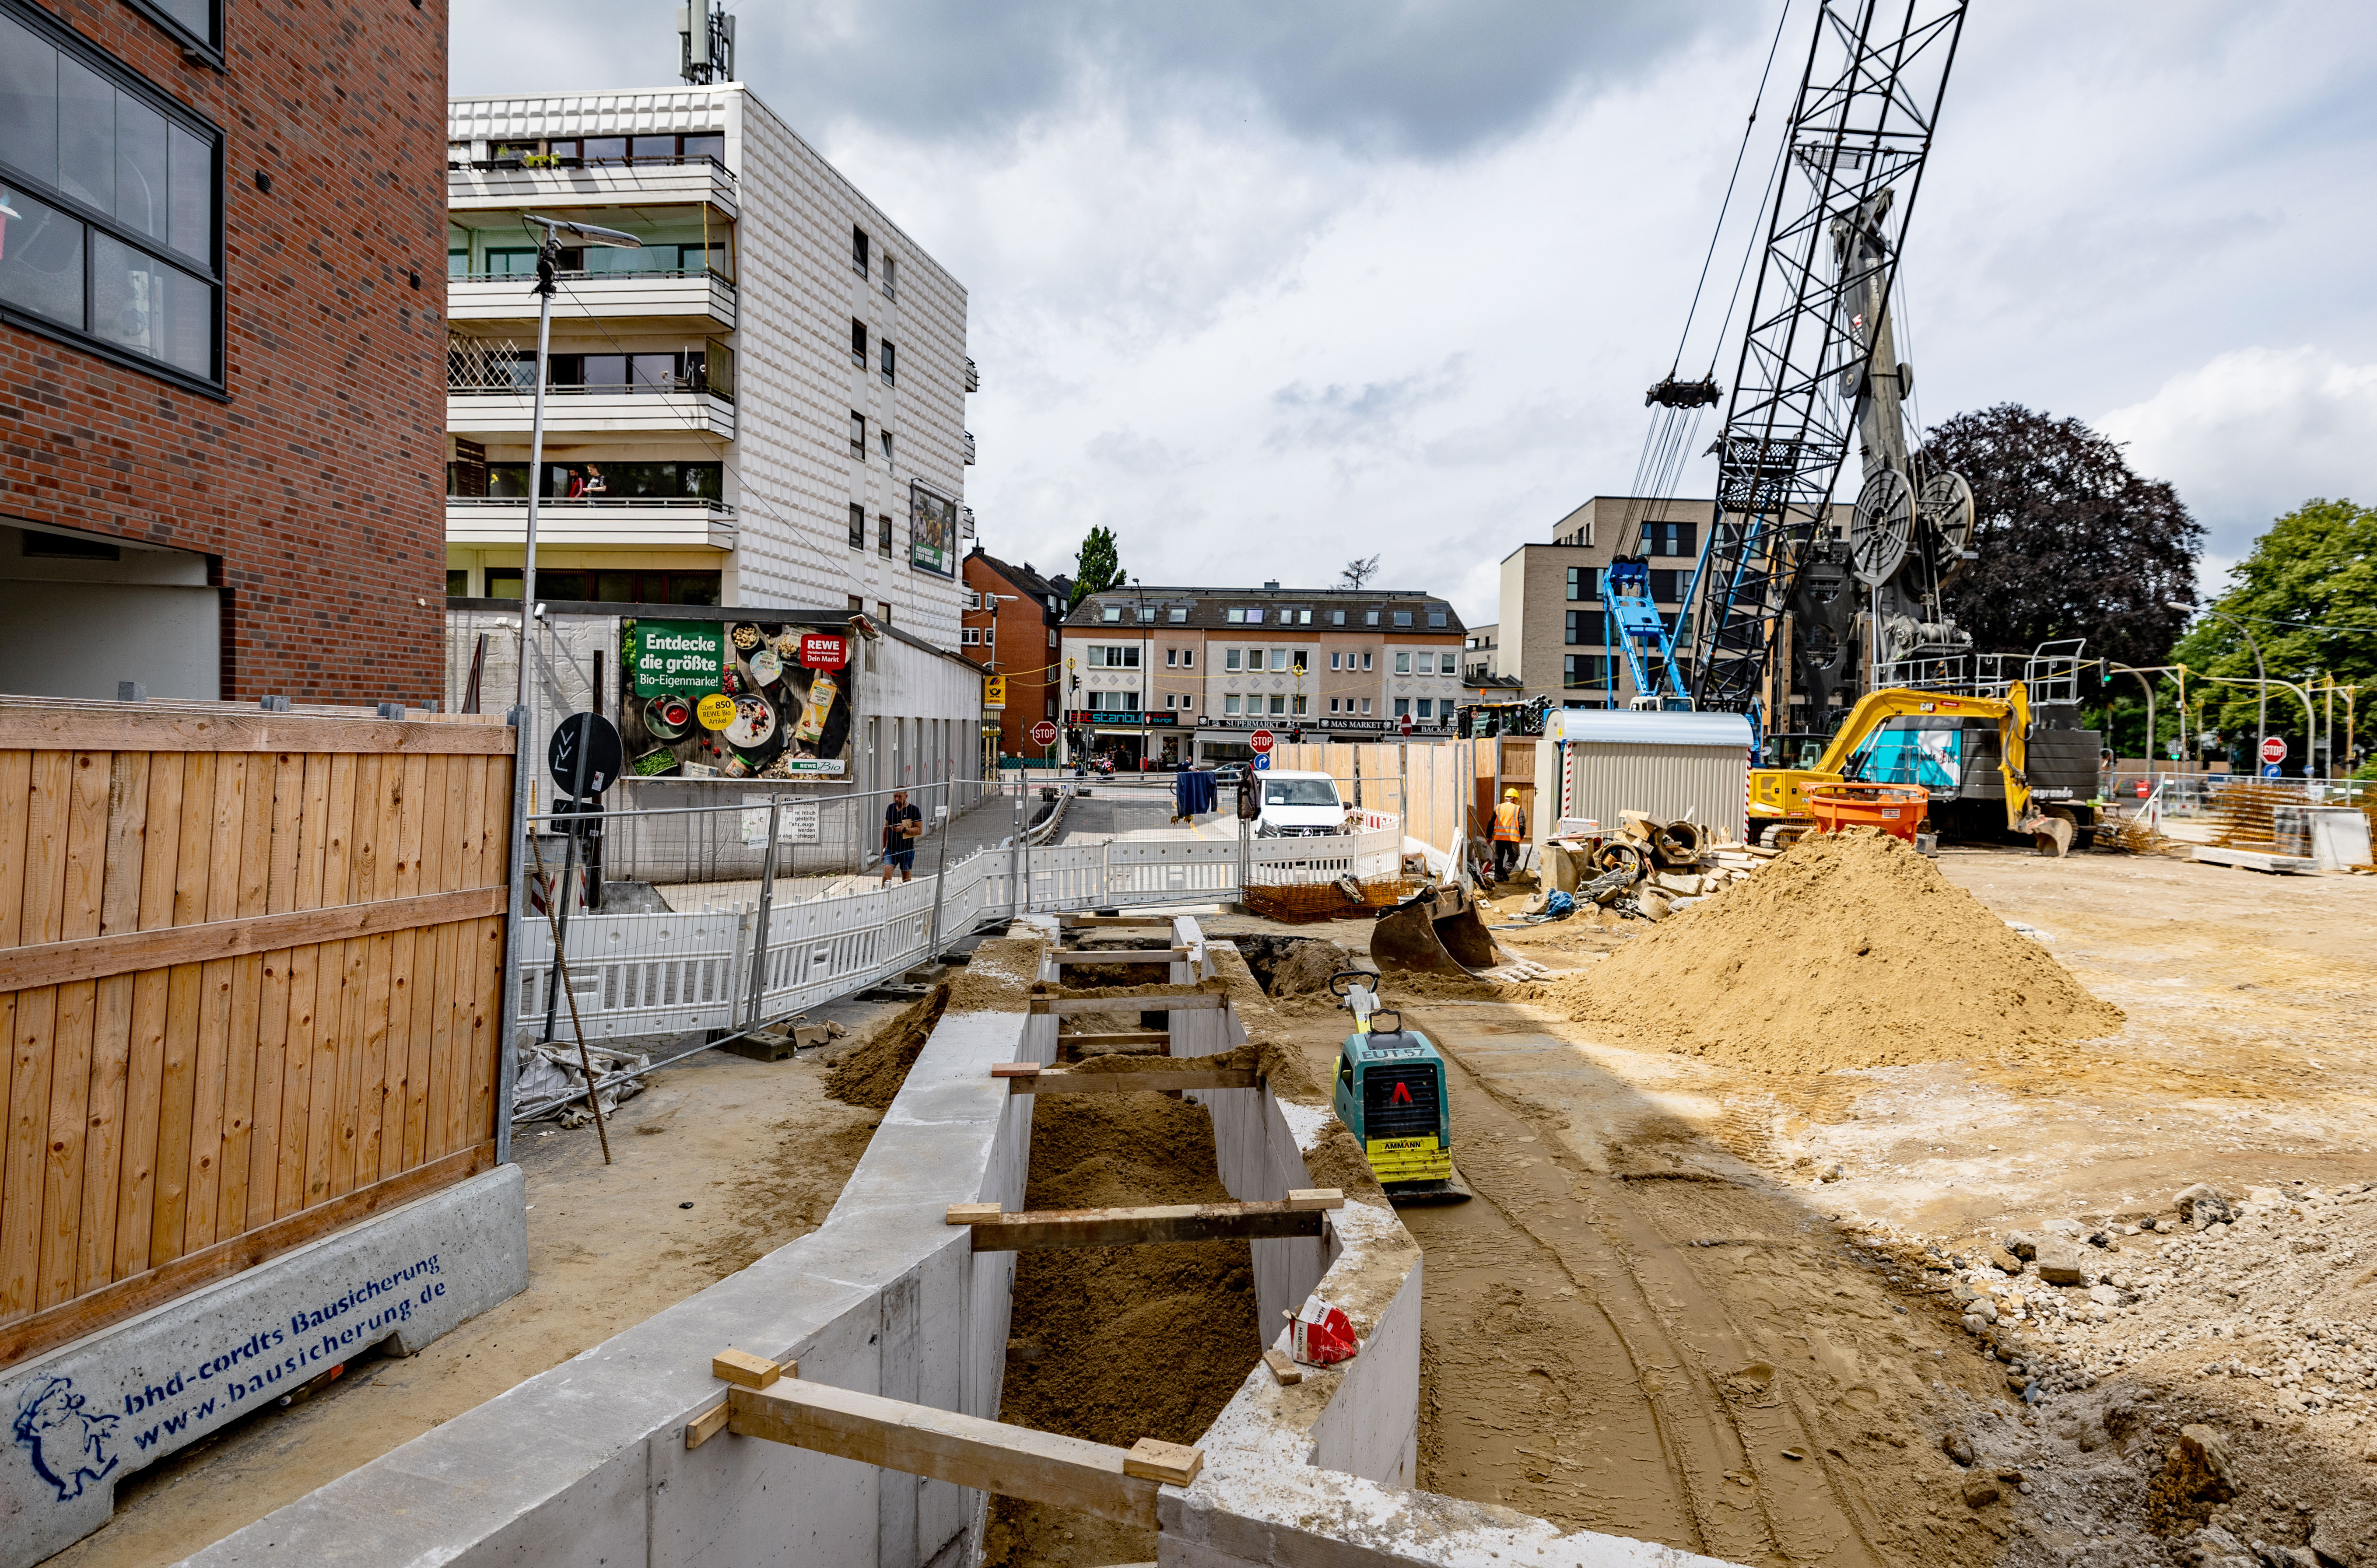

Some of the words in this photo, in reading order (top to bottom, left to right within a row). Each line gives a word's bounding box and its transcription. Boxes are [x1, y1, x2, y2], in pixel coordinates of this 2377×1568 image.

[646, 634, 716, 651] Entdecke
[807, 640, 840, 650] REWE
[640, 654, 663, 669] die
[666, 655, 717, 674] größte
[640, 674, 719, 688] Bio-Eigenmarke!
[715, 700, 731, 709] 850
[1920, 703, 1934, 711] CAT
[1071, 711, 1143, 723] eatstanbul
[1035, 729, 1055, 738] STOP
[1253, 737, 1272, 746] STOP
[2263, 745, 2284, 756] STOP
[818, 762, 841, 771] Bio
[1362, 1050, 1399, 1059] EUT
[124, 1329, 284, 1416] bhd-cordts
[291, 1254, 440, 1335] Bausicherung
[134, 1282, 446, 1450] www.bausicherung.de
